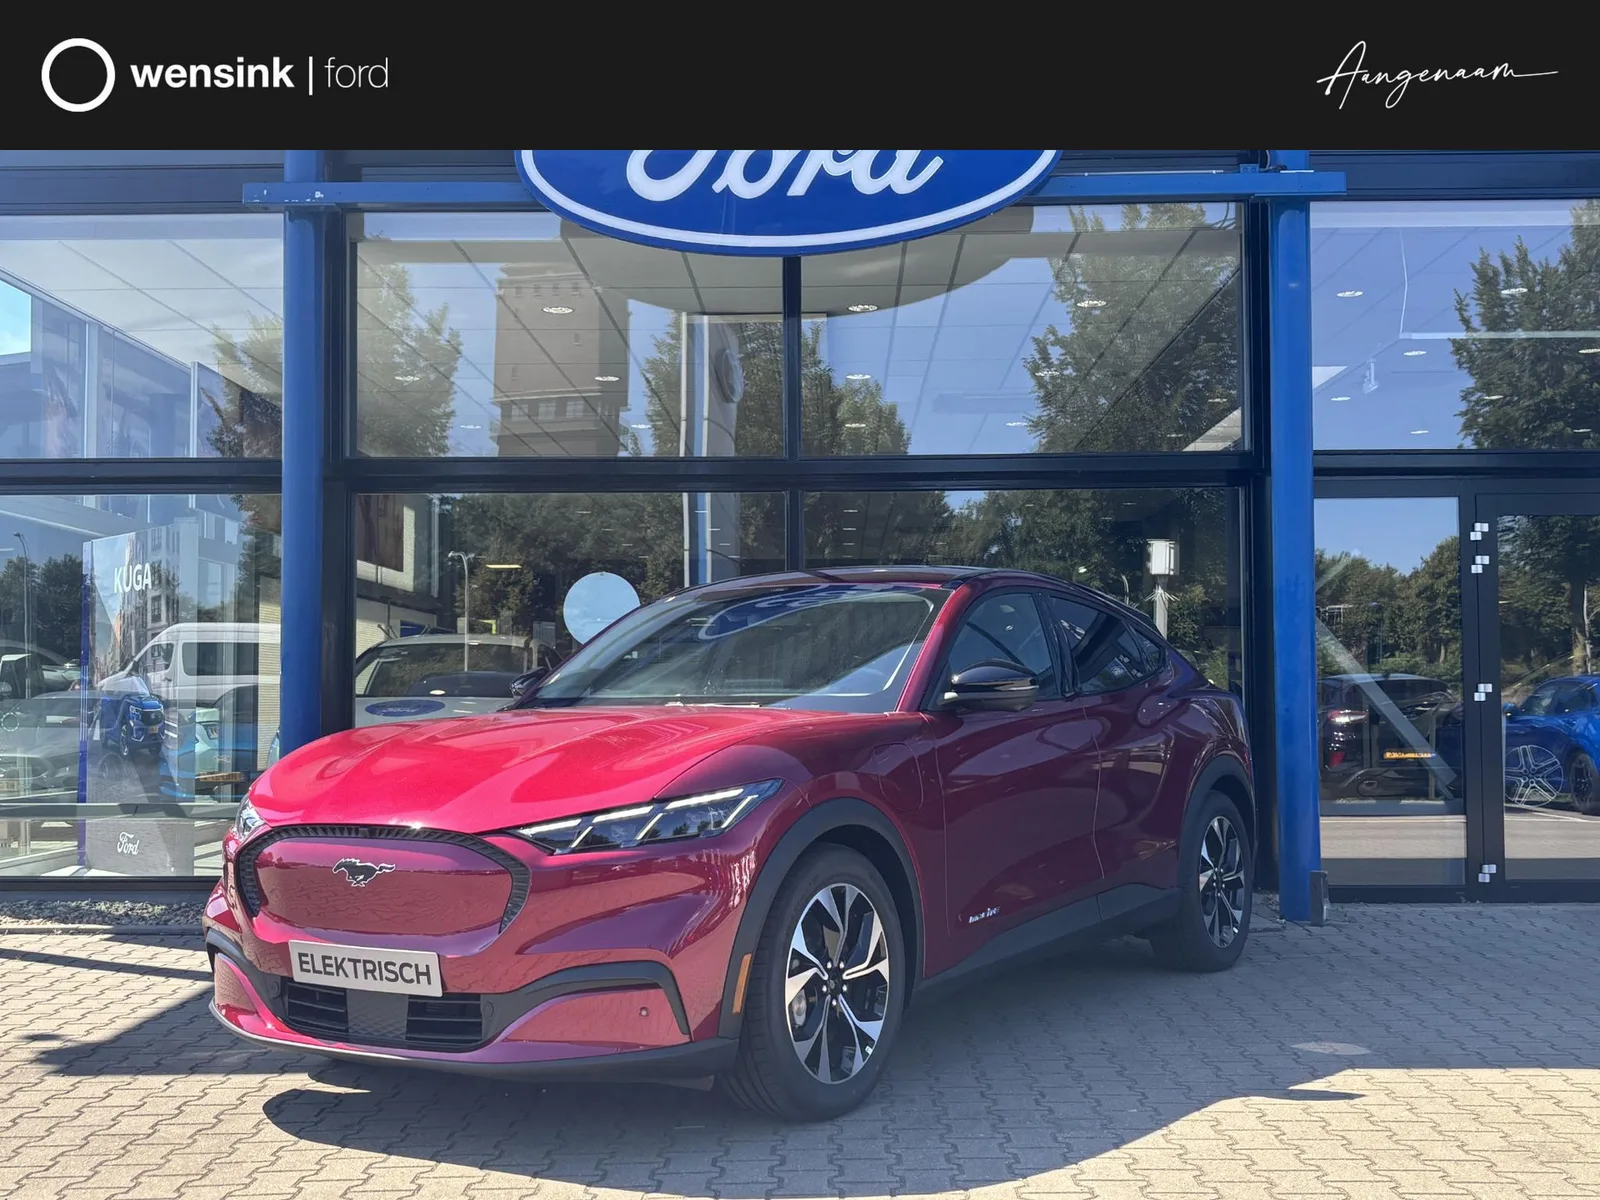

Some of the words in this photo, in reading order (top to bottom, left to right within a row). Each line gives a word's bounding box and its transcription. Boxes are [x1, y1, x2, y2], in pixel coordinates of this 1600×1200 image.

[114, 562, 152, 593] KUGA
[116, 831, 140, 855] Ford
[297, 952, 432, 985] ELEKTRISCH
